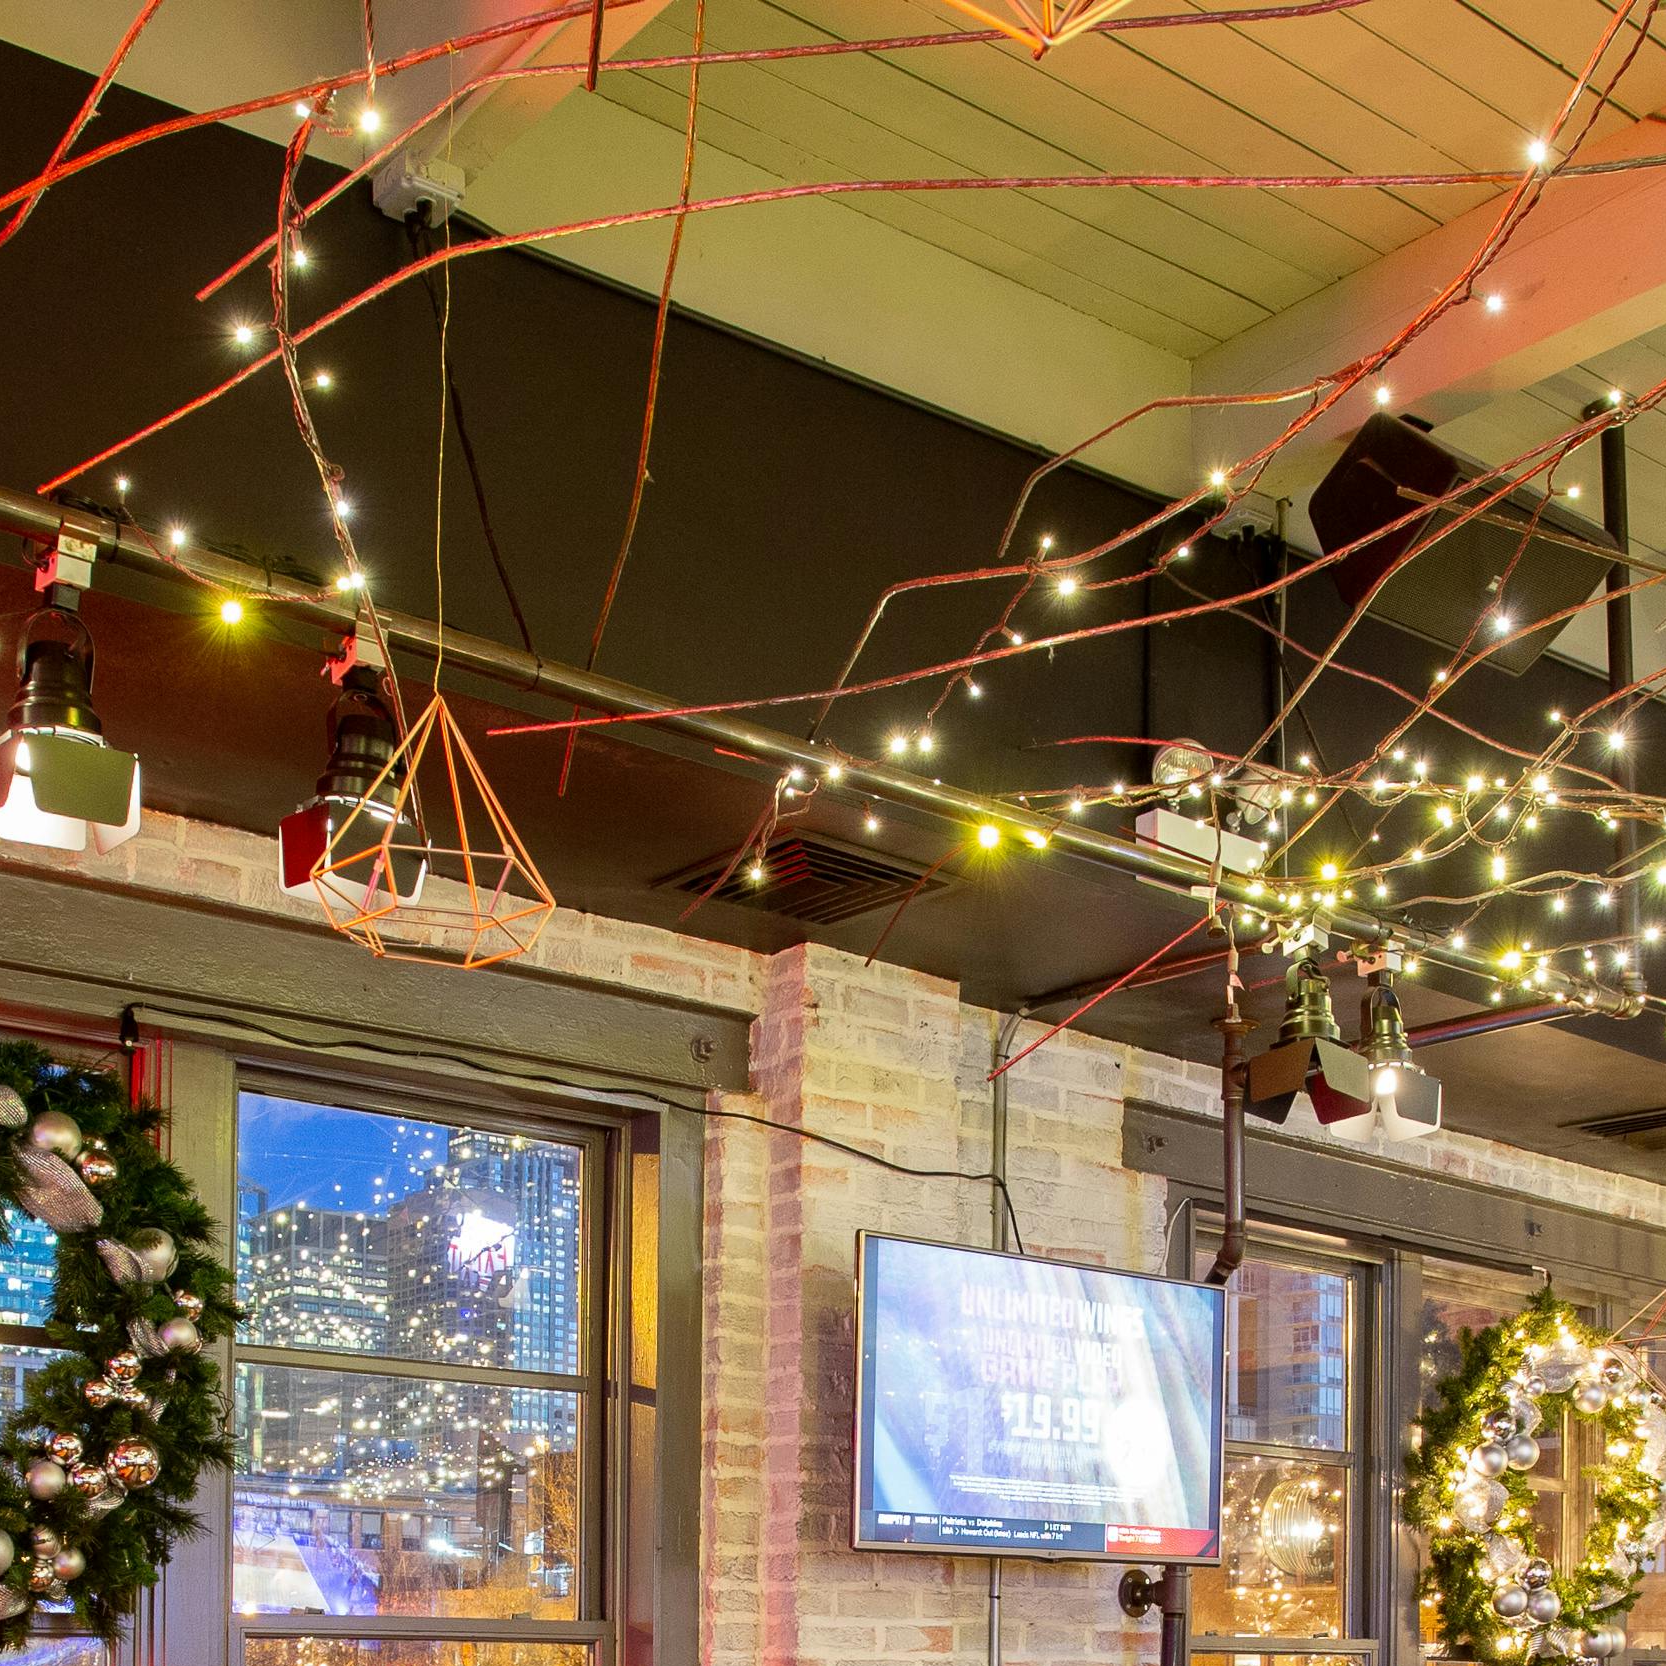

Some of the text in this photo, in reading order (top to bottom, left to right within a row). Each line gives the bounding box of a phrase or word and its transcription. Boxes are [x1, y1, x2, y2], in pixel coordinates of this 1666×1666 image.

[961, 1282, 1074, 1329] UNLIMITED
[982, 1354, 1054, 1388] GAME
[1074, 1338, 1122, 1369] VIDEO
[1000, 1390, 1102, 1444] $19.99
